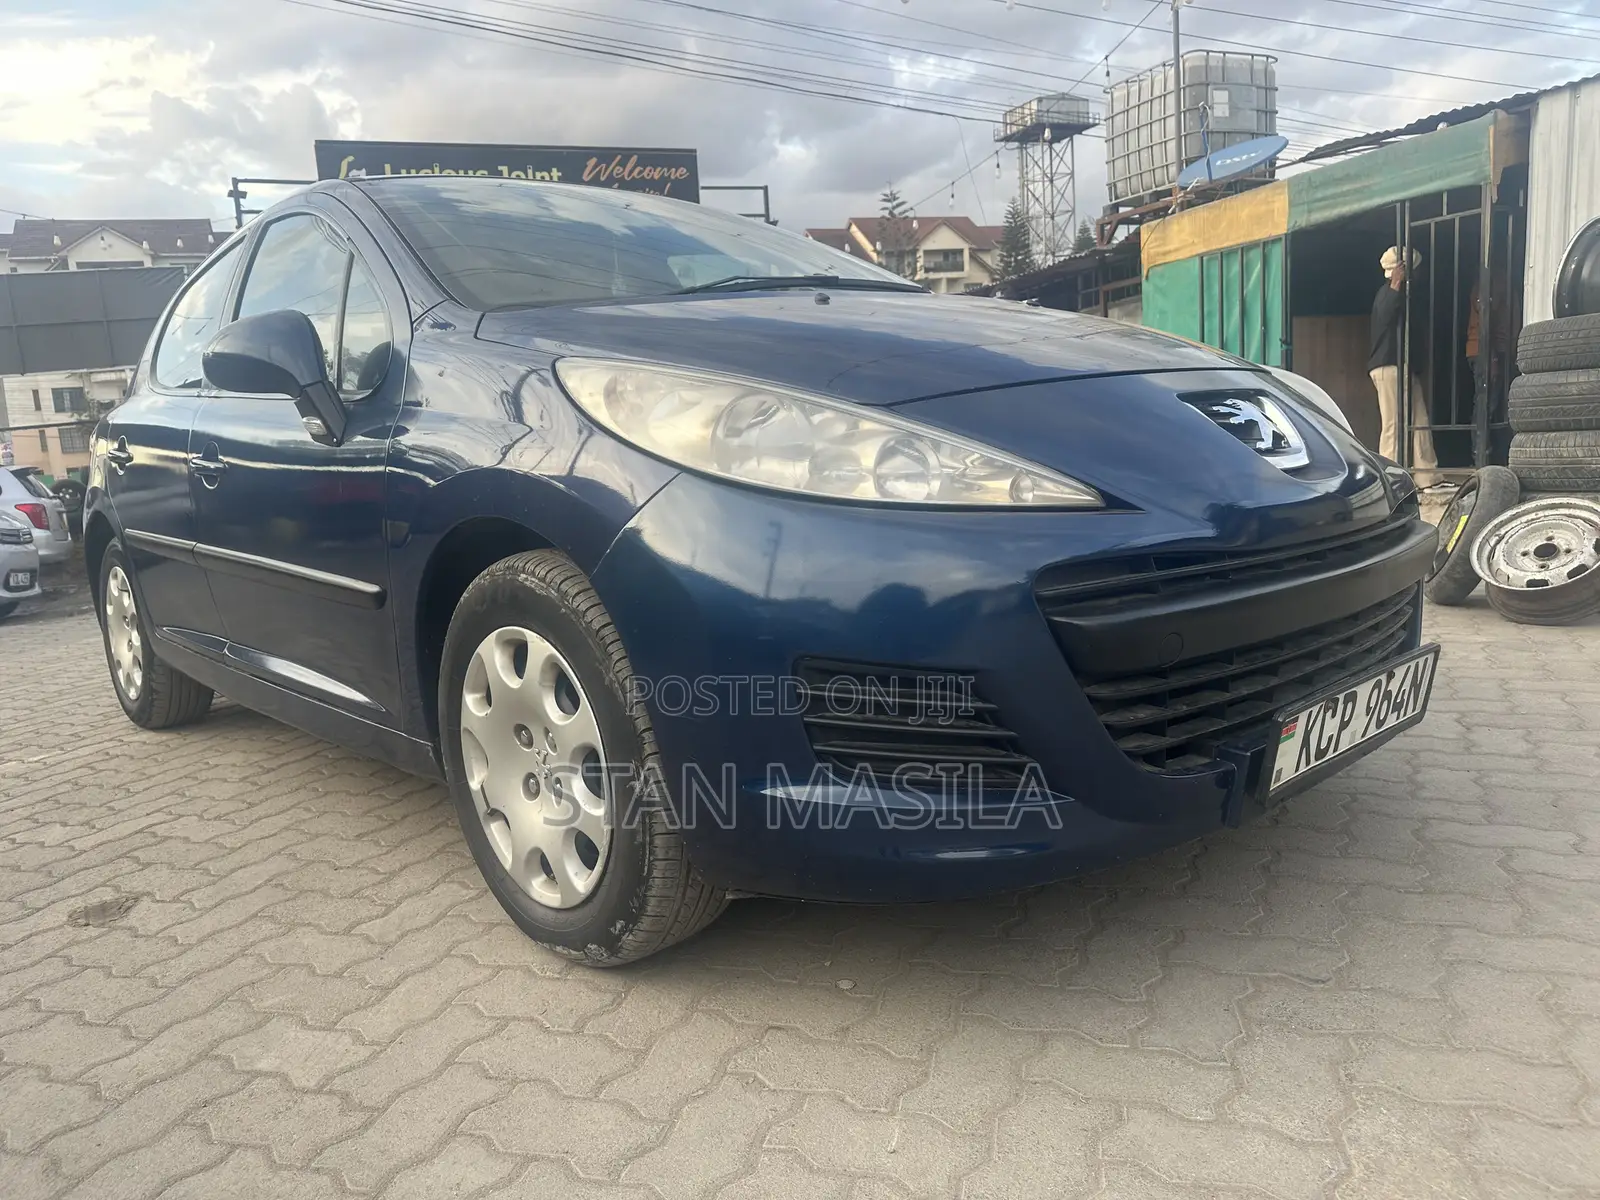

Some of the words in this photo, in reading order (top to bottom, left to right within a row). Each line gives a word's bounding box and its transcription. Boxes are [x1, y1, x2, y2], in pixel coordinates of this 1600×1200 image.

[582, 154, 689, 182] Welcome
[1294, 690, 1358, 773] KCP
[1361, 656, 1429, 739] 964N
